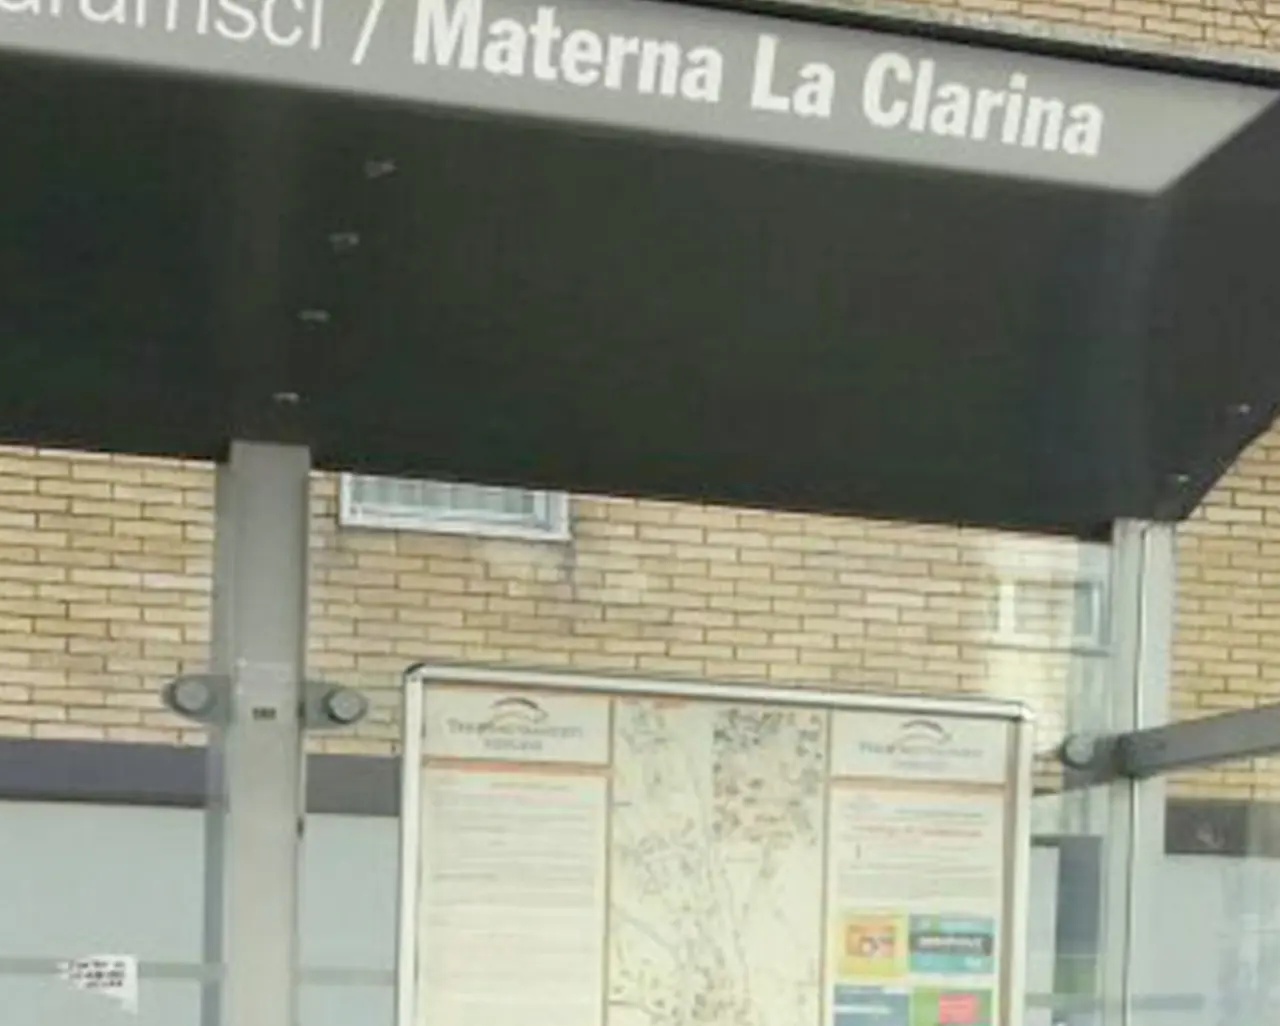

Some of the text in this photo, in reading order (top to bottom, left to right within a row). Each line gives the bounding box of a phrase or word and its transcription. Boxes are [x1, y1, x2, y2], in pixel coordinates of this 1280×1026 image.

[410, 0, 722, 102] Materna
[748, 33, 837, 118] La
[861, 50, 1106, 158] Clarina
